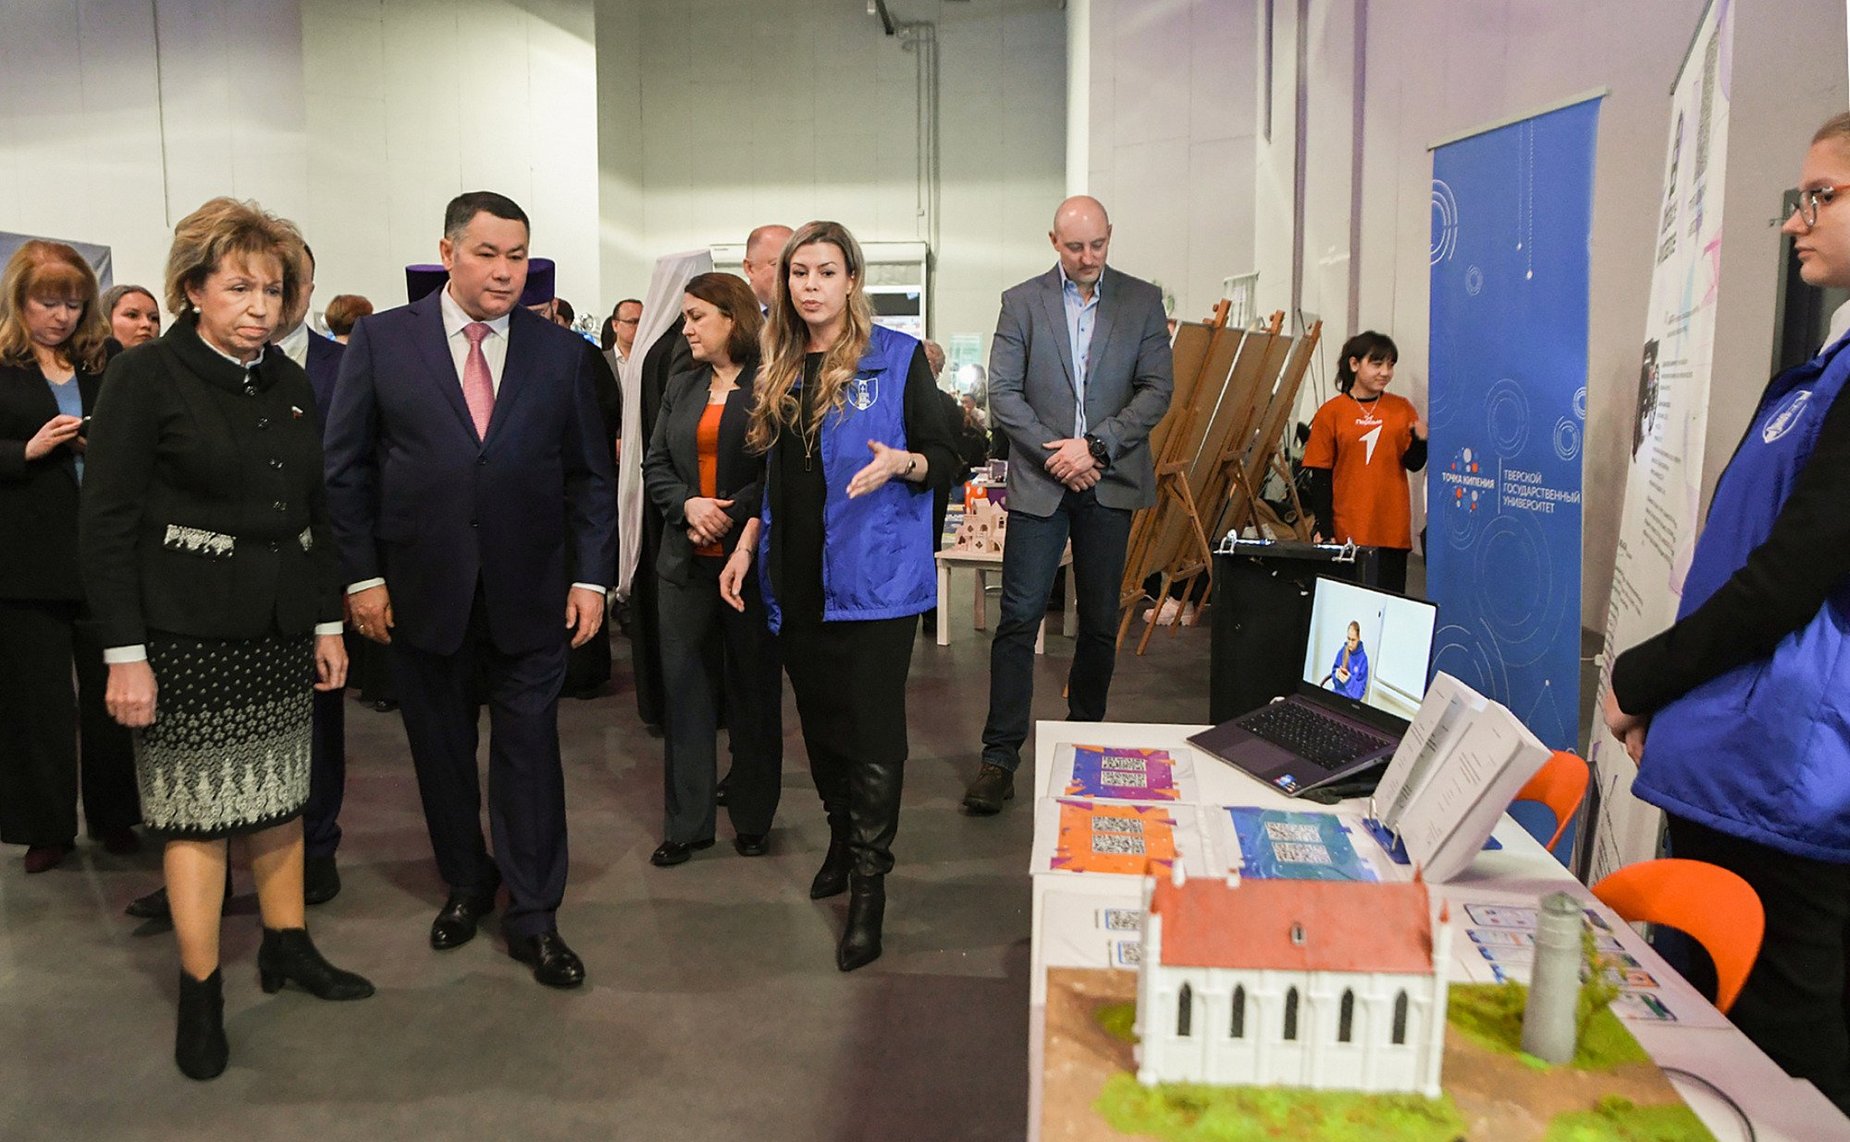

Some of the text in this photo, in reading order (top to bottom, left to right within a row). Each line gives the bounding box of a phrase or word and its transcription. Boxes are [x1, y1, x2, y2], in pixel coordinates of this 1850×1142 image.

[1441, 472, 1462, 484] ТОЧКА
[1503, 469, 1542, 484] ТВЕРСКОЙ
[1503, 482, 1581, 504] ГОСУДАРСТВЕННЫЙ
[1502, 495, 1556, 513] УНИВЕРСИТЕТ
